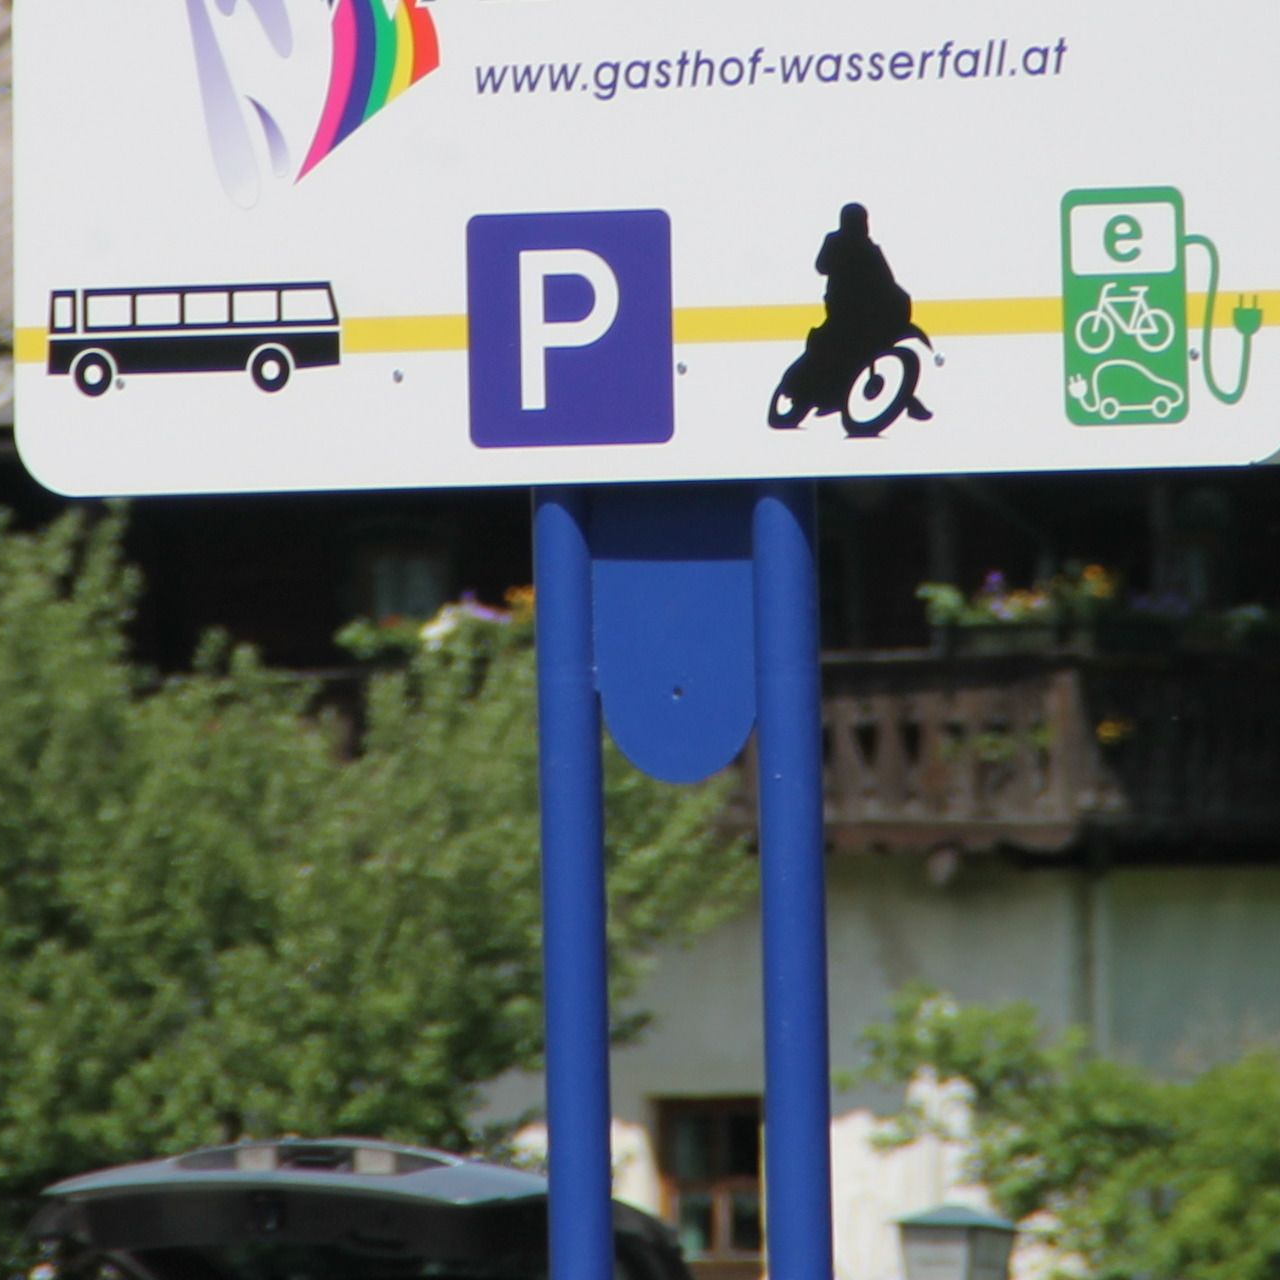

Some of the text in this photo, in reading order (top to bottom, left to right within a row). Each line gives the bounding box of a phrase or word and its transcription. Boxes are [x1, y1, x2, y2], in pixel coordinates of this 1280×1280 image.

[474, 38, 1068, 100] www.gasthof-wasserfall.at
[1103, 214, 1143, 263] e
[518, 248, 619, 412] P
